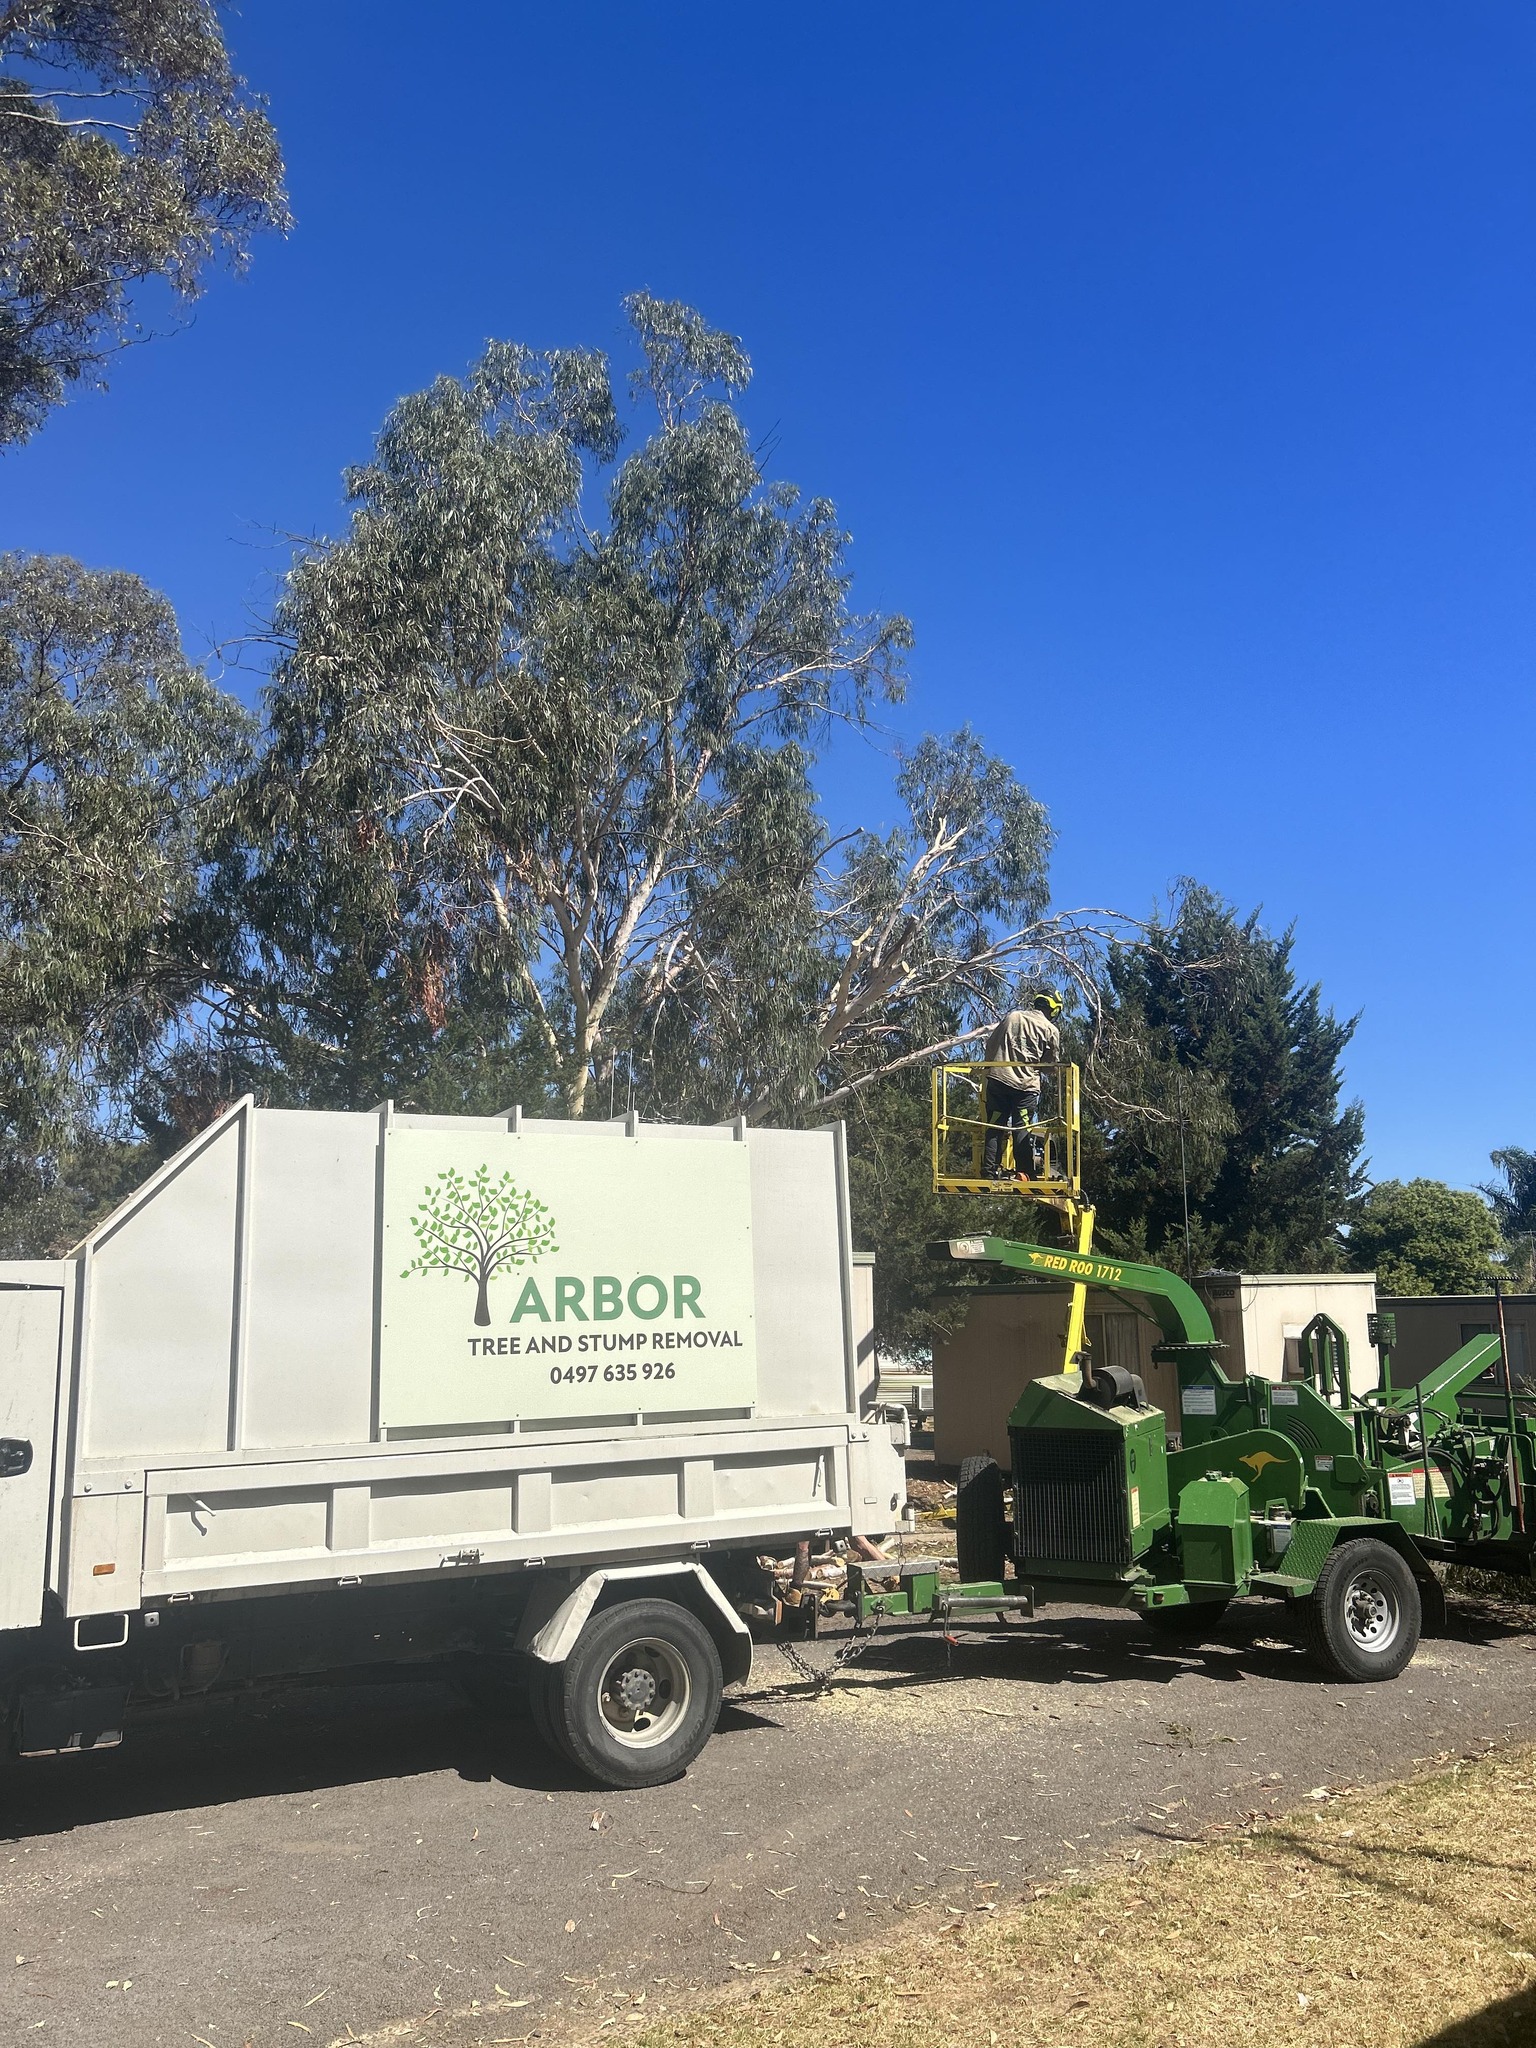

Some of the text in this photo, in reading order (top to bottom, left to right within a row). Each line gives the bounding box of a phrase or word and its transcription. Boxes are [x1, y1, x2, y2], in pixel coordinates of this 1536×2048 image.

[1043, 1255, 1122, 1281] RED ROO 1712
[509, 1275, 706, 1323] ARBOR
[467, 1330, 743, 1356] TREE AND STUMP REMOVAL
[550, 1362, 676, 1384] 0497 635 926
